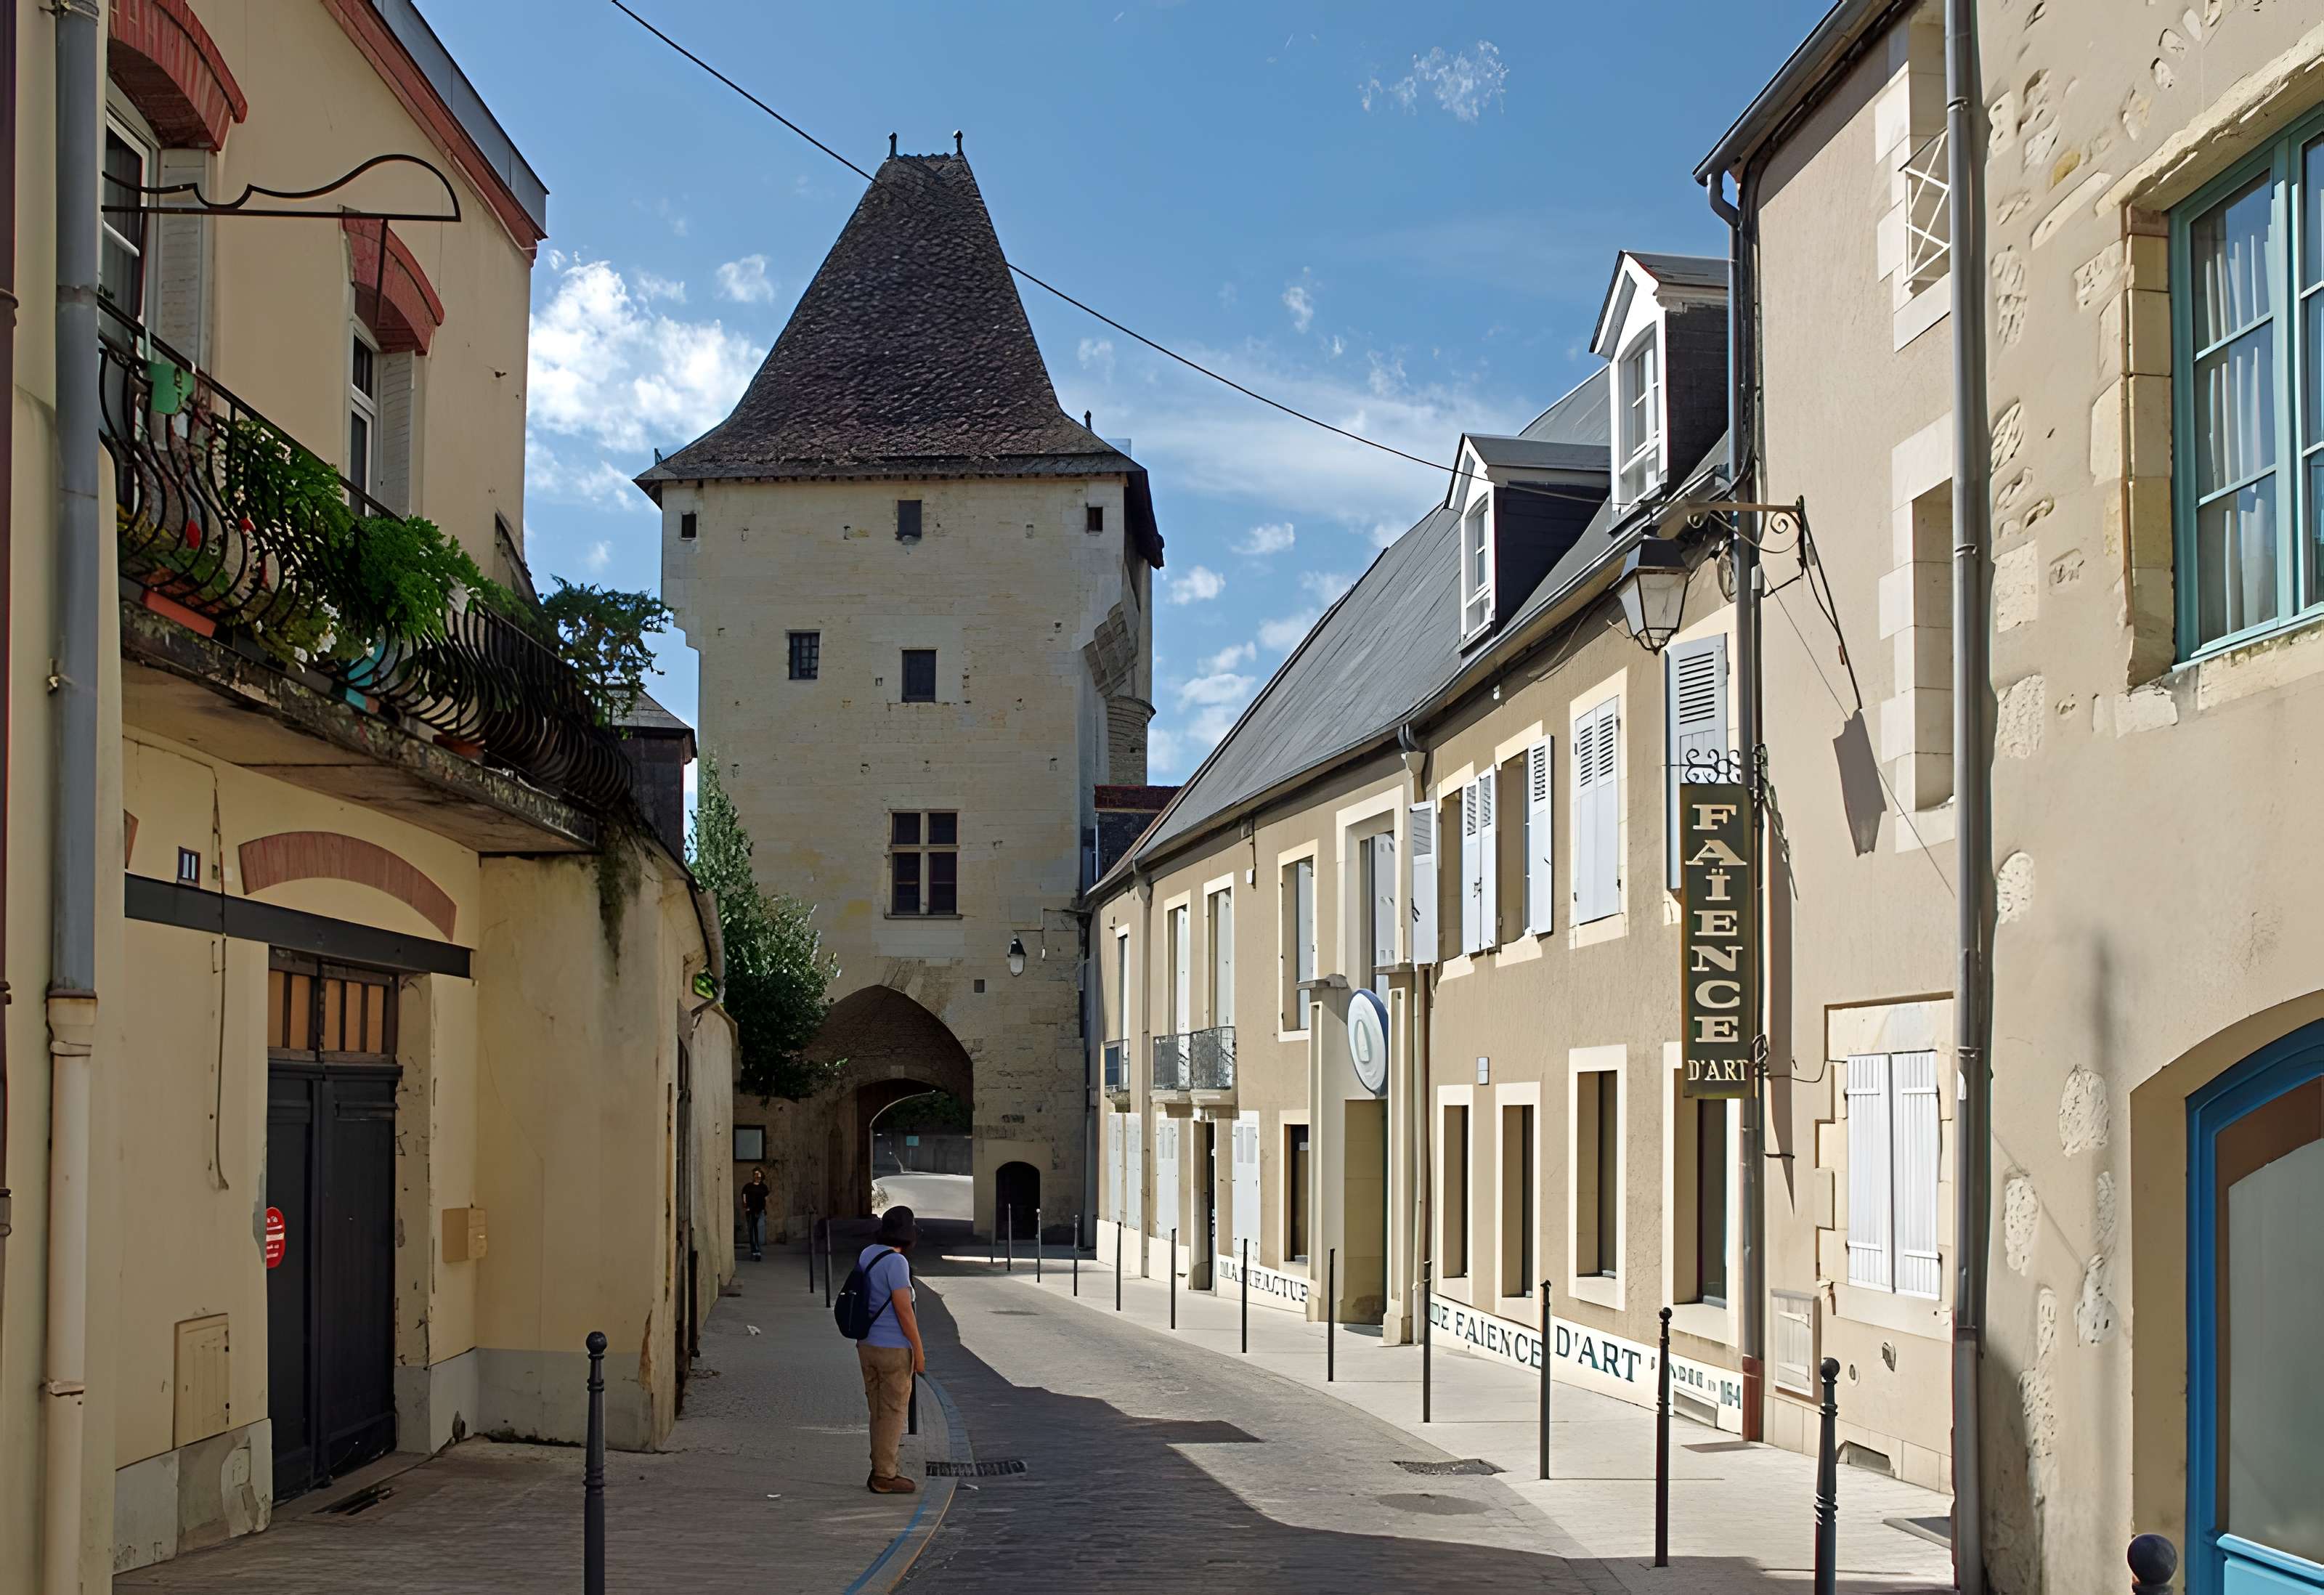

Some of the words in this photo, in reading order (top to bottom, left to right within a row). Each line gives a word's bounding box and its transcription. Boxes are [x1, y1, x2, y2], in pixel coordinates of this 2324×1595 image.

[1685, 804, 1747, 1042] FAÏENCE
[1687, 1059, 1749, 1081] D'ART
[1430, 1302, 1450, 1331] DE
[1555, 1325, 1641, 1383] D'ART
